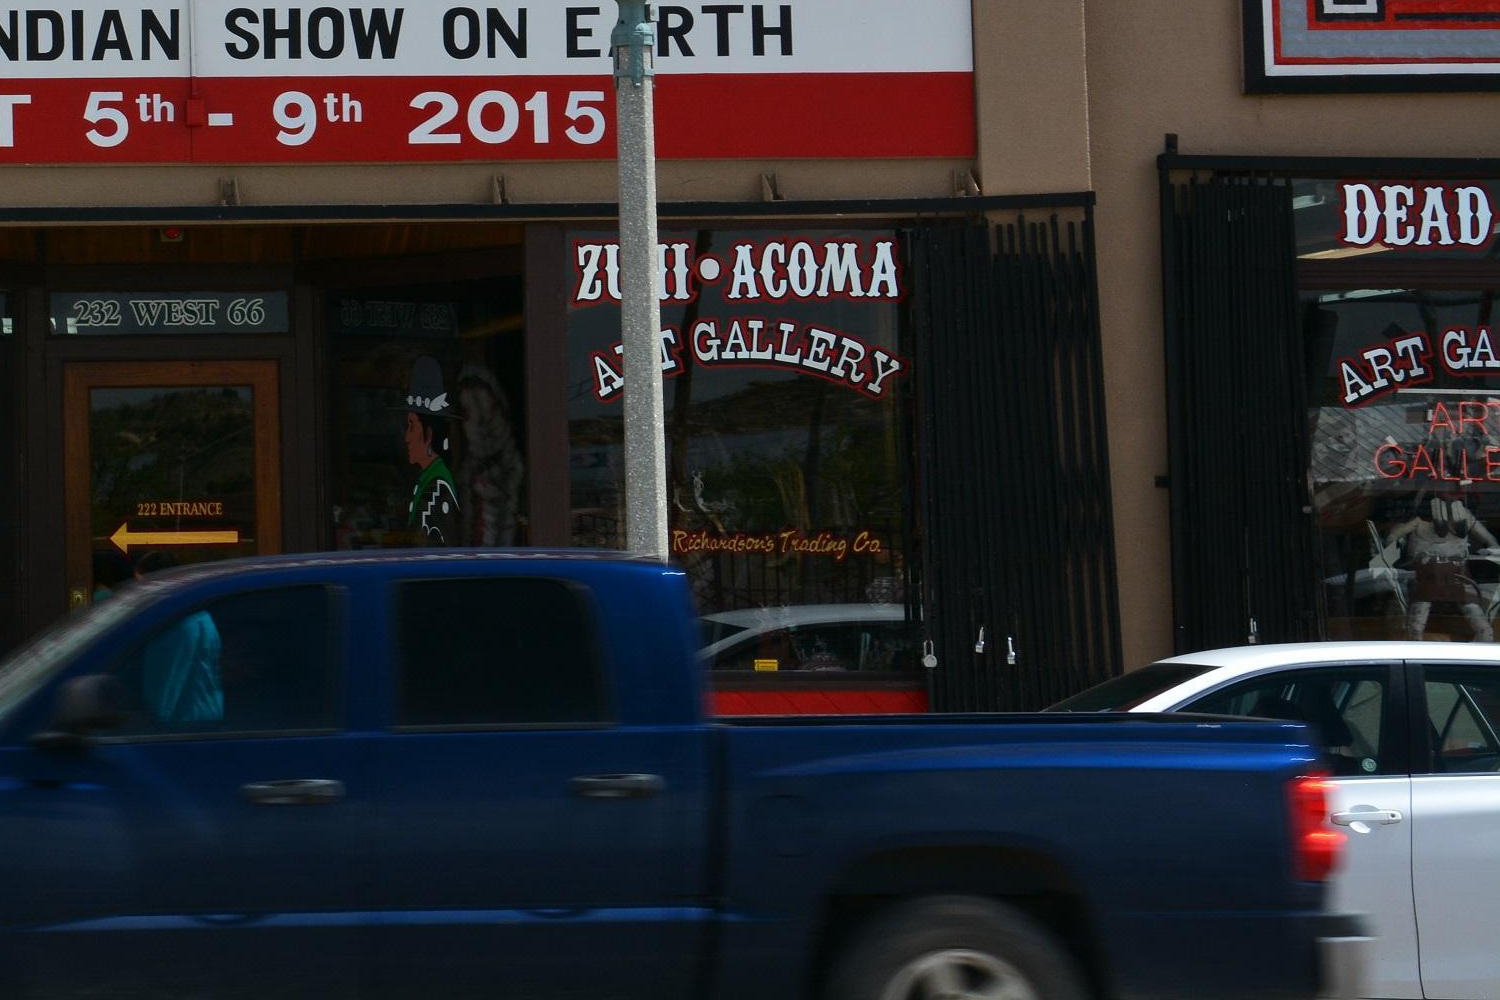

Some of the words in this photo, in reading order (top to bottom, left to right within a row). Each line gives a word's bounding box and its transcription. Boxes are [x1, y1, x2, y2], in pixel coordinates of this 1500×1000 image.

[225, 7, 404, 59] SHOW
[443, 7, 526, 59] ON
[566, 4, 792, 58] ERTH
[85, 92, 174, 147] 5th
[273, 91, 361, 145] 9th
[409, 91, 605, 144] 2015
[1343, 184, 1493, 246] DEAD
[727, 241, 898, 299] ACOMA
[74, 300, 122, 326] 232
[130, 300, 219, 326] WEST
[228, 299, 265, 326] 66
[594, 328, 677, 398] AT
[693, 320, 900, 394] GALLERY
[1341, 336, 1425, 403] ART
[1443, 329, 1500, 370] GA
[137, 503, 157, 516] 222
[160, 502, 223, 516] ENTRANCE
[672, 530, 774, 553] Richardson's
[780, 530, 847, 560] Trading
[853, 531, 882, 553] Co.
